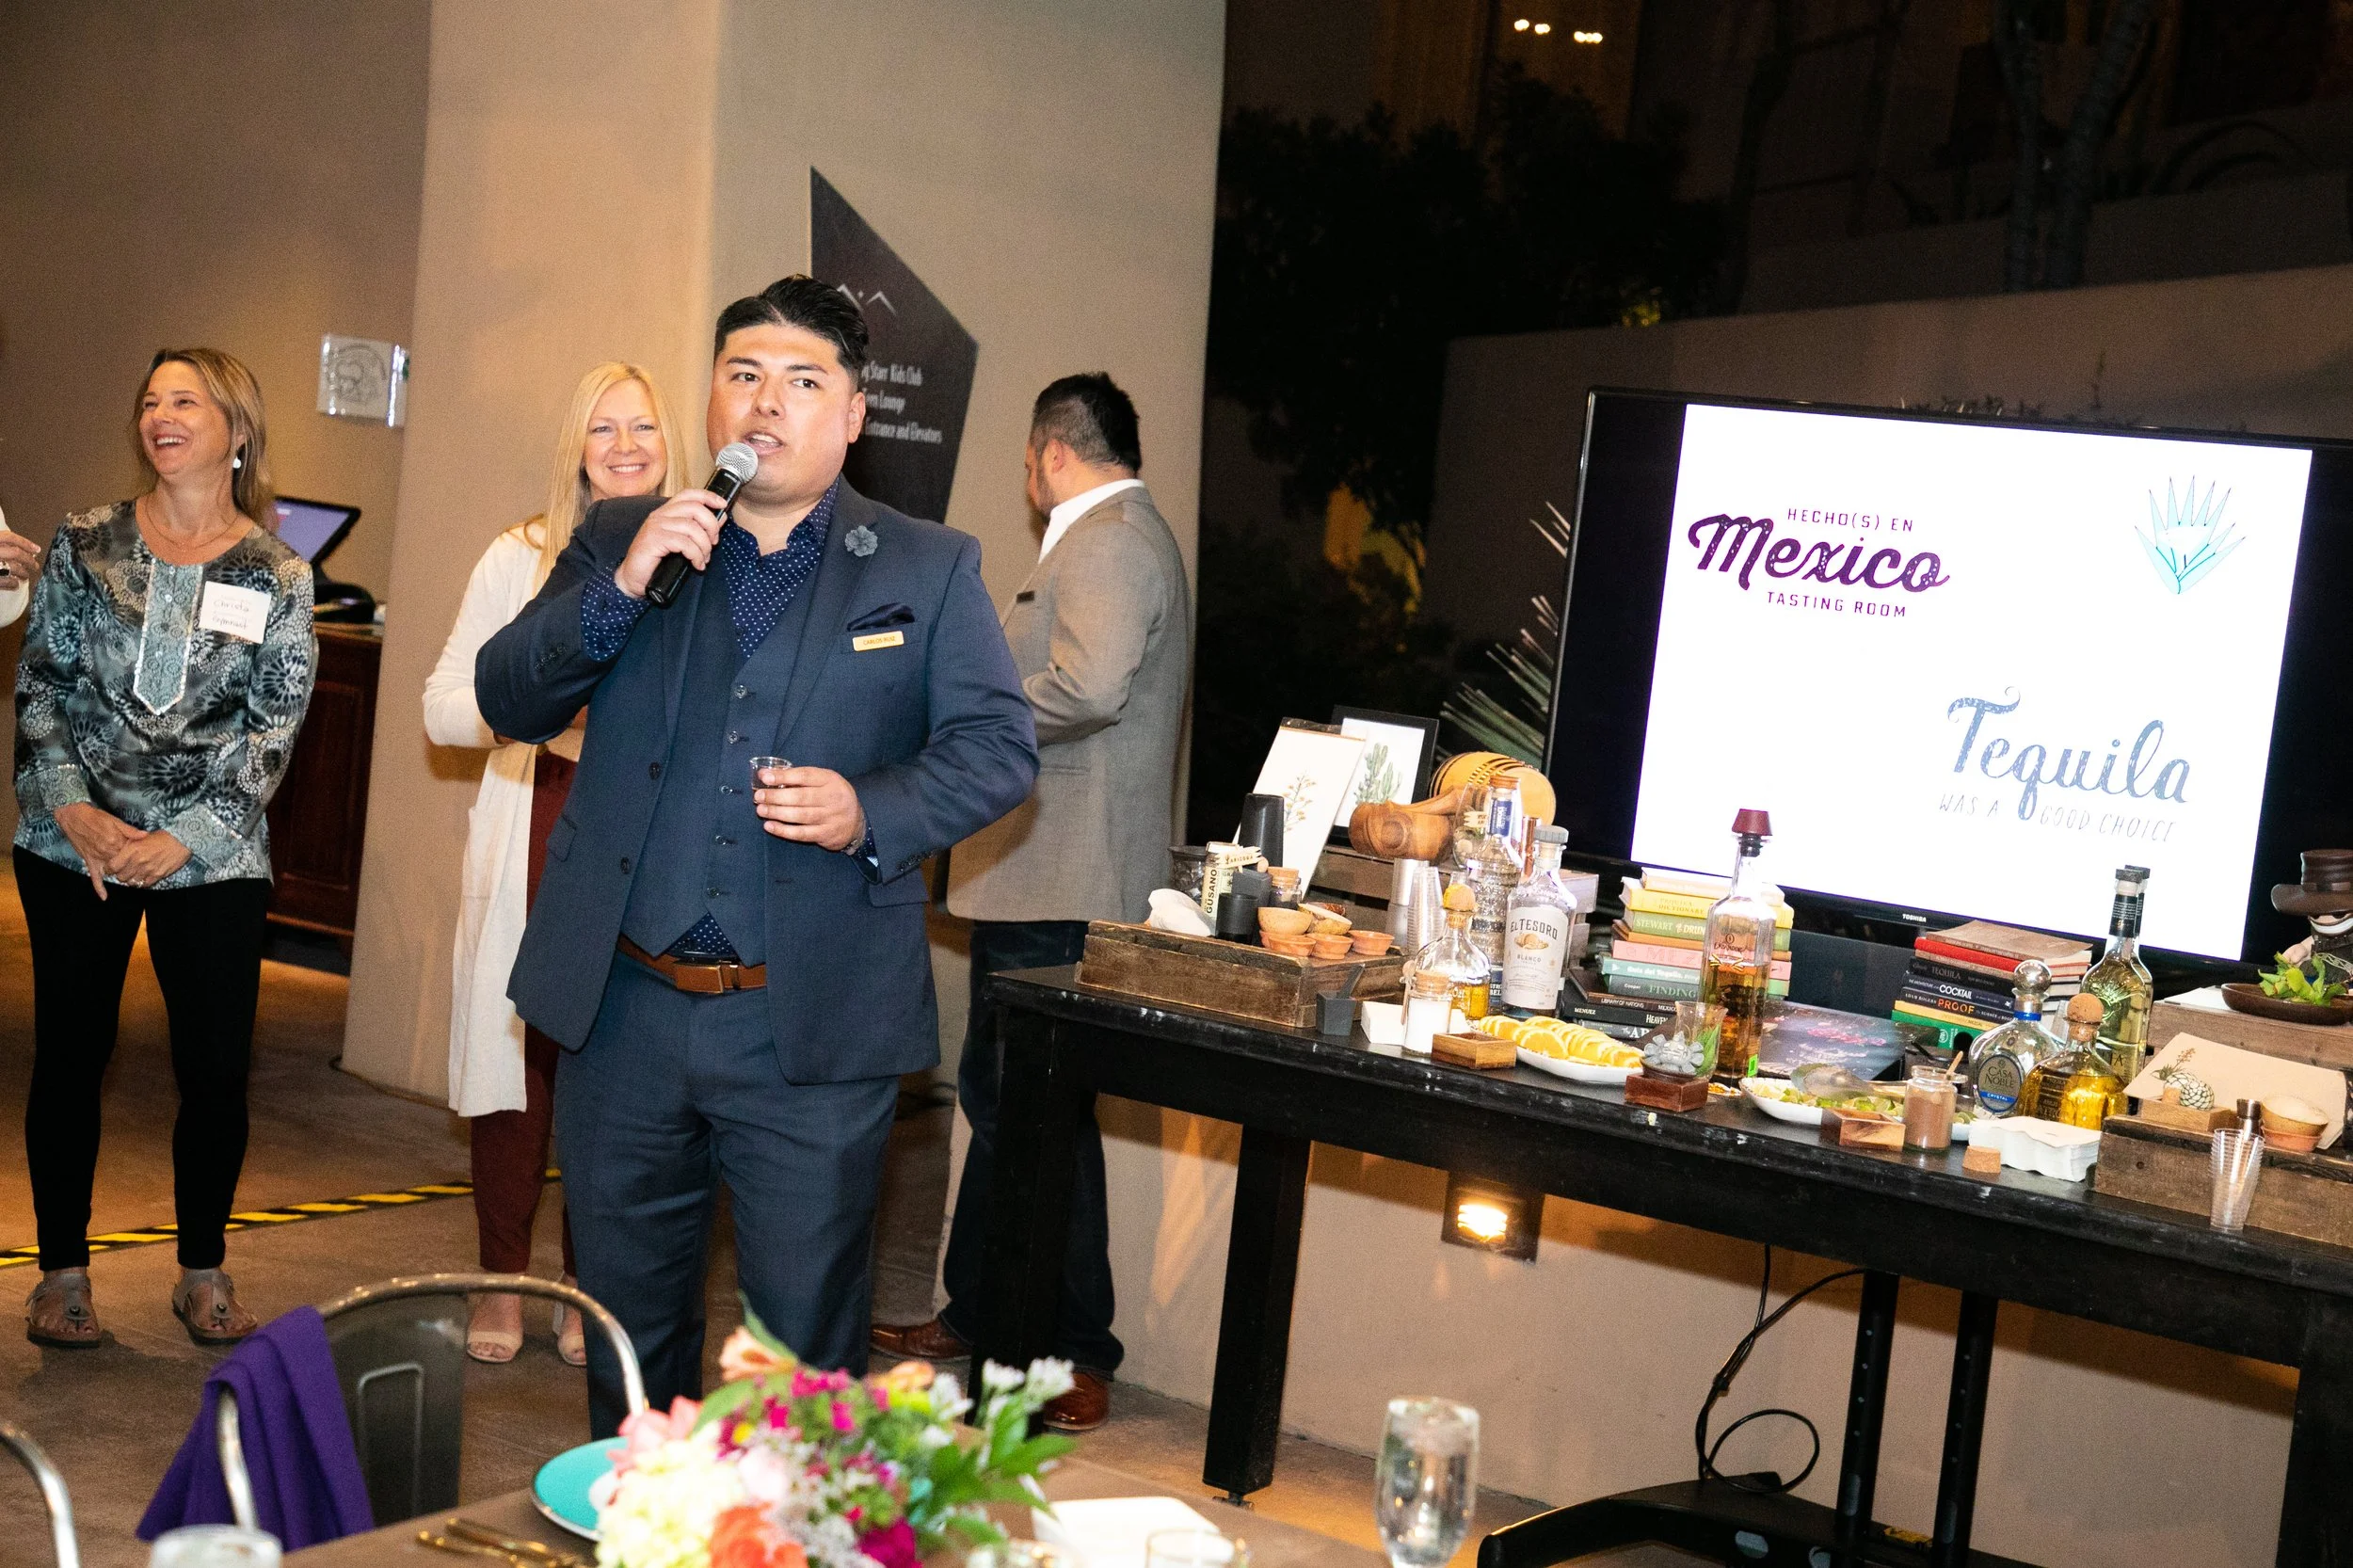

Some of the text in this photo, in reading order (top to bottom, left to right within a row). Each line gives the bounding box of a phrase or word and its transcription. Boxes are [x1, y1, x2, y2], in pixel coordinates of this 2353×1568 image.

[1787, 507, 1913, 533] HECHO(S) EN
[1688, 512, 1951, 594] Mexico
[1767, 591, 1906, 618] TASTING ROOM
[1946, 685, 2191, 822] Tequila
[1939, 793, 1978, 815] WAS
[1987, 799, 1999, 817] A
[2040, 805, 2090, 831] GOOD
[1230, 856, 1254, 864] ARIZONA
[1206, 869, 1218, 914] GUSANO
[1636, 918, 1673, 931] STEWART
[1902, 913, 1927, 923] TOSHIBA
[1511, 921, 1518, 933] EL
[1519, 919, 1558, 940] TESORO
[1517, 954, 1542, 963] BLANCO
[1931, 966, 1961, 980] TEQUILA
[1649, 984, 1697, 998] FINDING
[1939, 984, 1973, 1000] COCKTAIL
[1574, 1007, 1596, 1016] MENUEZ
[1625, 1000, 1644, 1009] NATIONS
[1937, 999, 1976, 1015] PROOF
[1988, 1065, 2012, 1080] CASA
[1984, 1073, 2015, 1088] NOBLE
[1987, 1093, 2009, 1101] CRYSTAL
